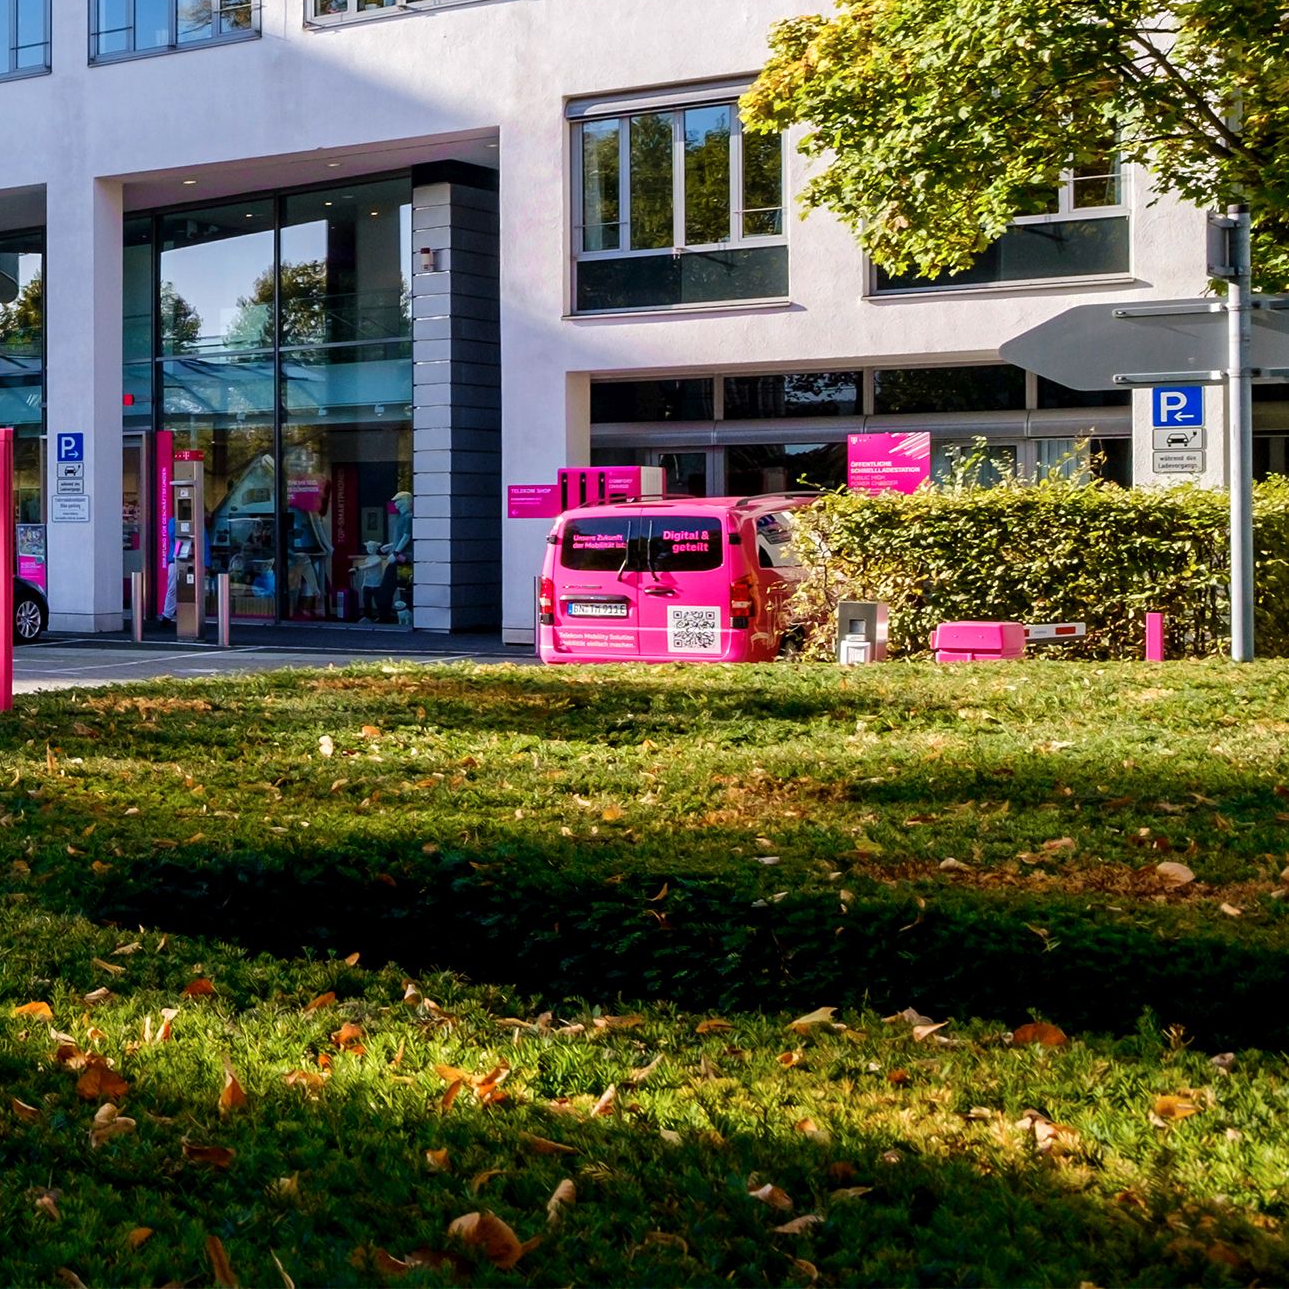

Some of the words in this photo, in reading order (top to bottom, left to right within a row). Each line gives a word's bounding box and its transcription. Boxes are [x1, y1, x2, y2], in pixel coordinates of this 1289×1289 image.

[1160, 391, 1188, 422] P
[61, 436, 76, 458] P
[663, 531, 700, 542] Digital
[701, 531, 709, 540] &
[672, 542, 709, 554] geteilt
